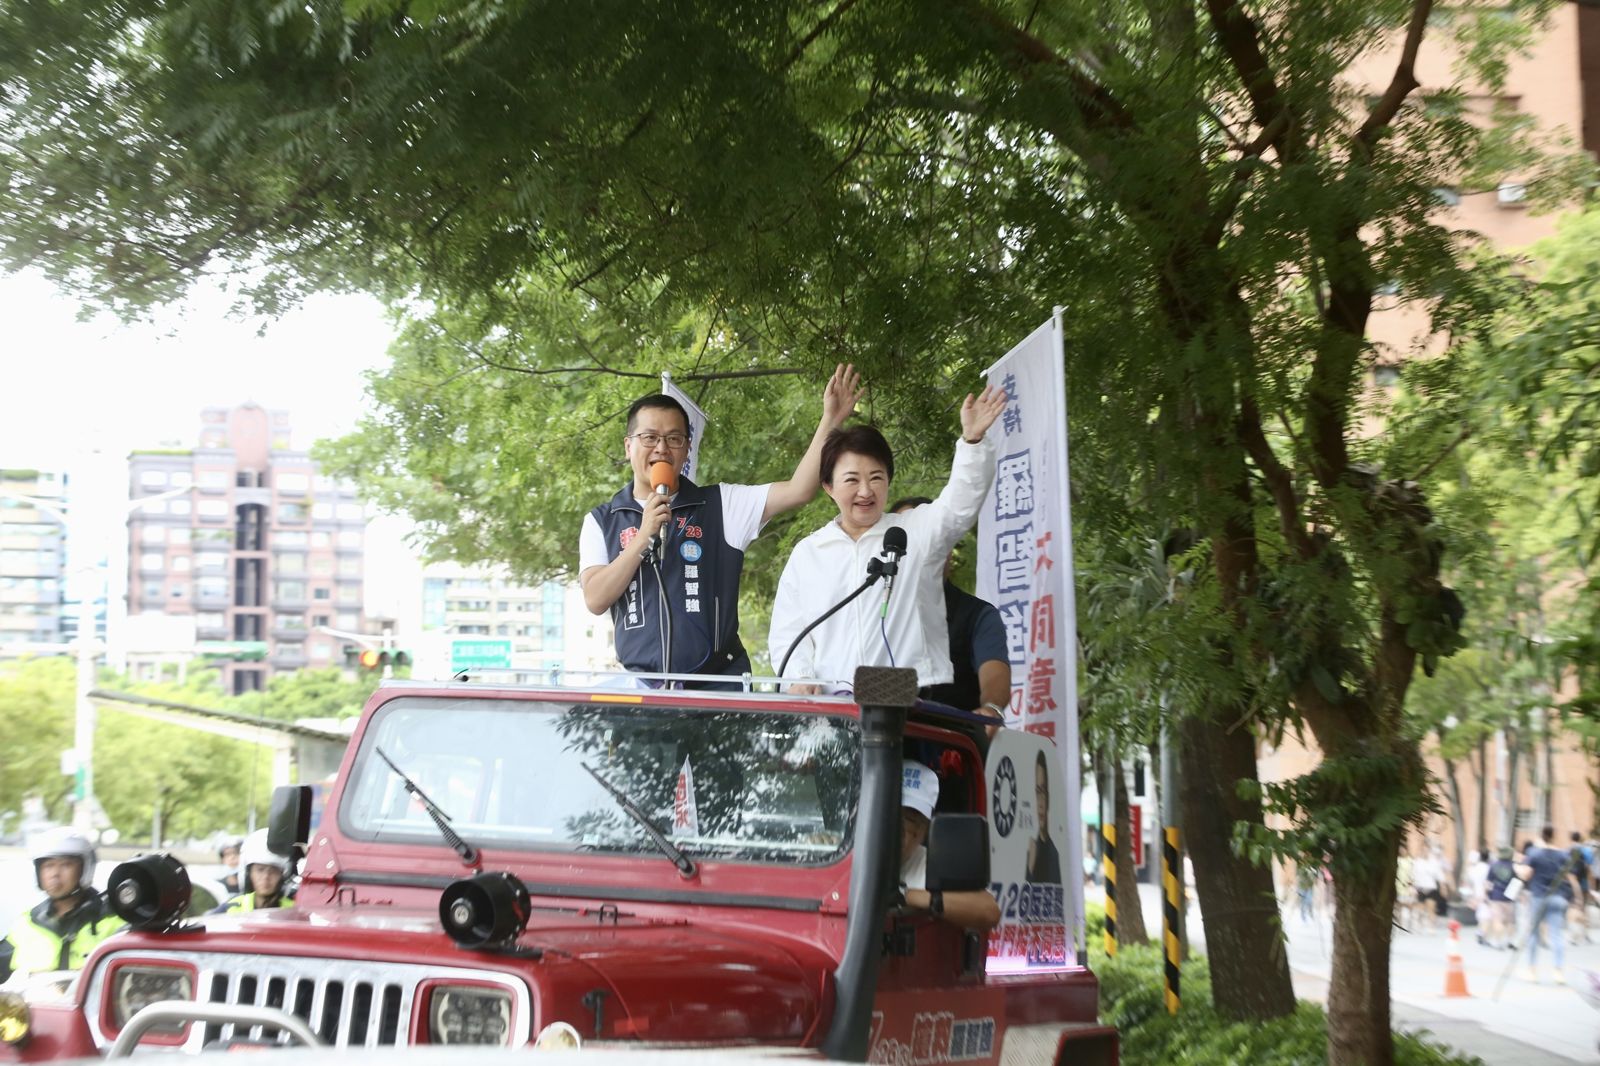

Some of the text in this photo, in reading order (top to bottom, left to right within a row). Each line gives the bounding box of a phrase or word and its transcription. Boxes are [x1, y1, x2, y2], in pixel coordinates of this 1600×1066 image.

[676, 515, 703, 538] 7/26
[684, 564, 701, 613] 羅智強
